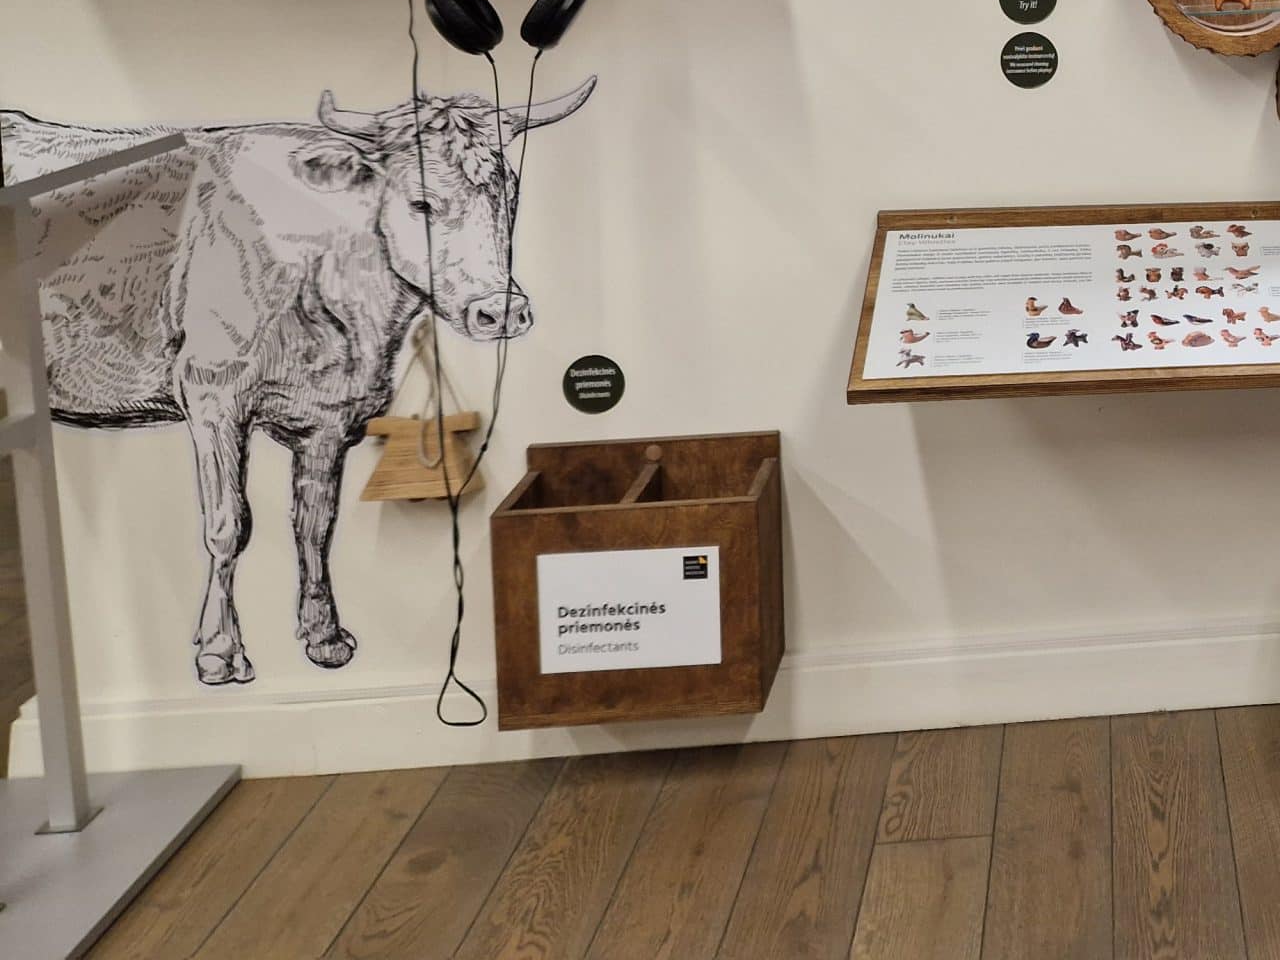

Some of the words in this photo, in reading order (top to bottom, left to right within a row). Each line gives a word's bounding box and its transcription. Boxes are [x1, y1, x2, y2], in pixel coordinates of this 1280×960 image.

[1019, 1, 1029, 11] Try
[558, 601, 666, 619] Dezinfekcinės
[558, 617, 640, 637] priemonės
[558, 640, 640, 656] Disinfectants
